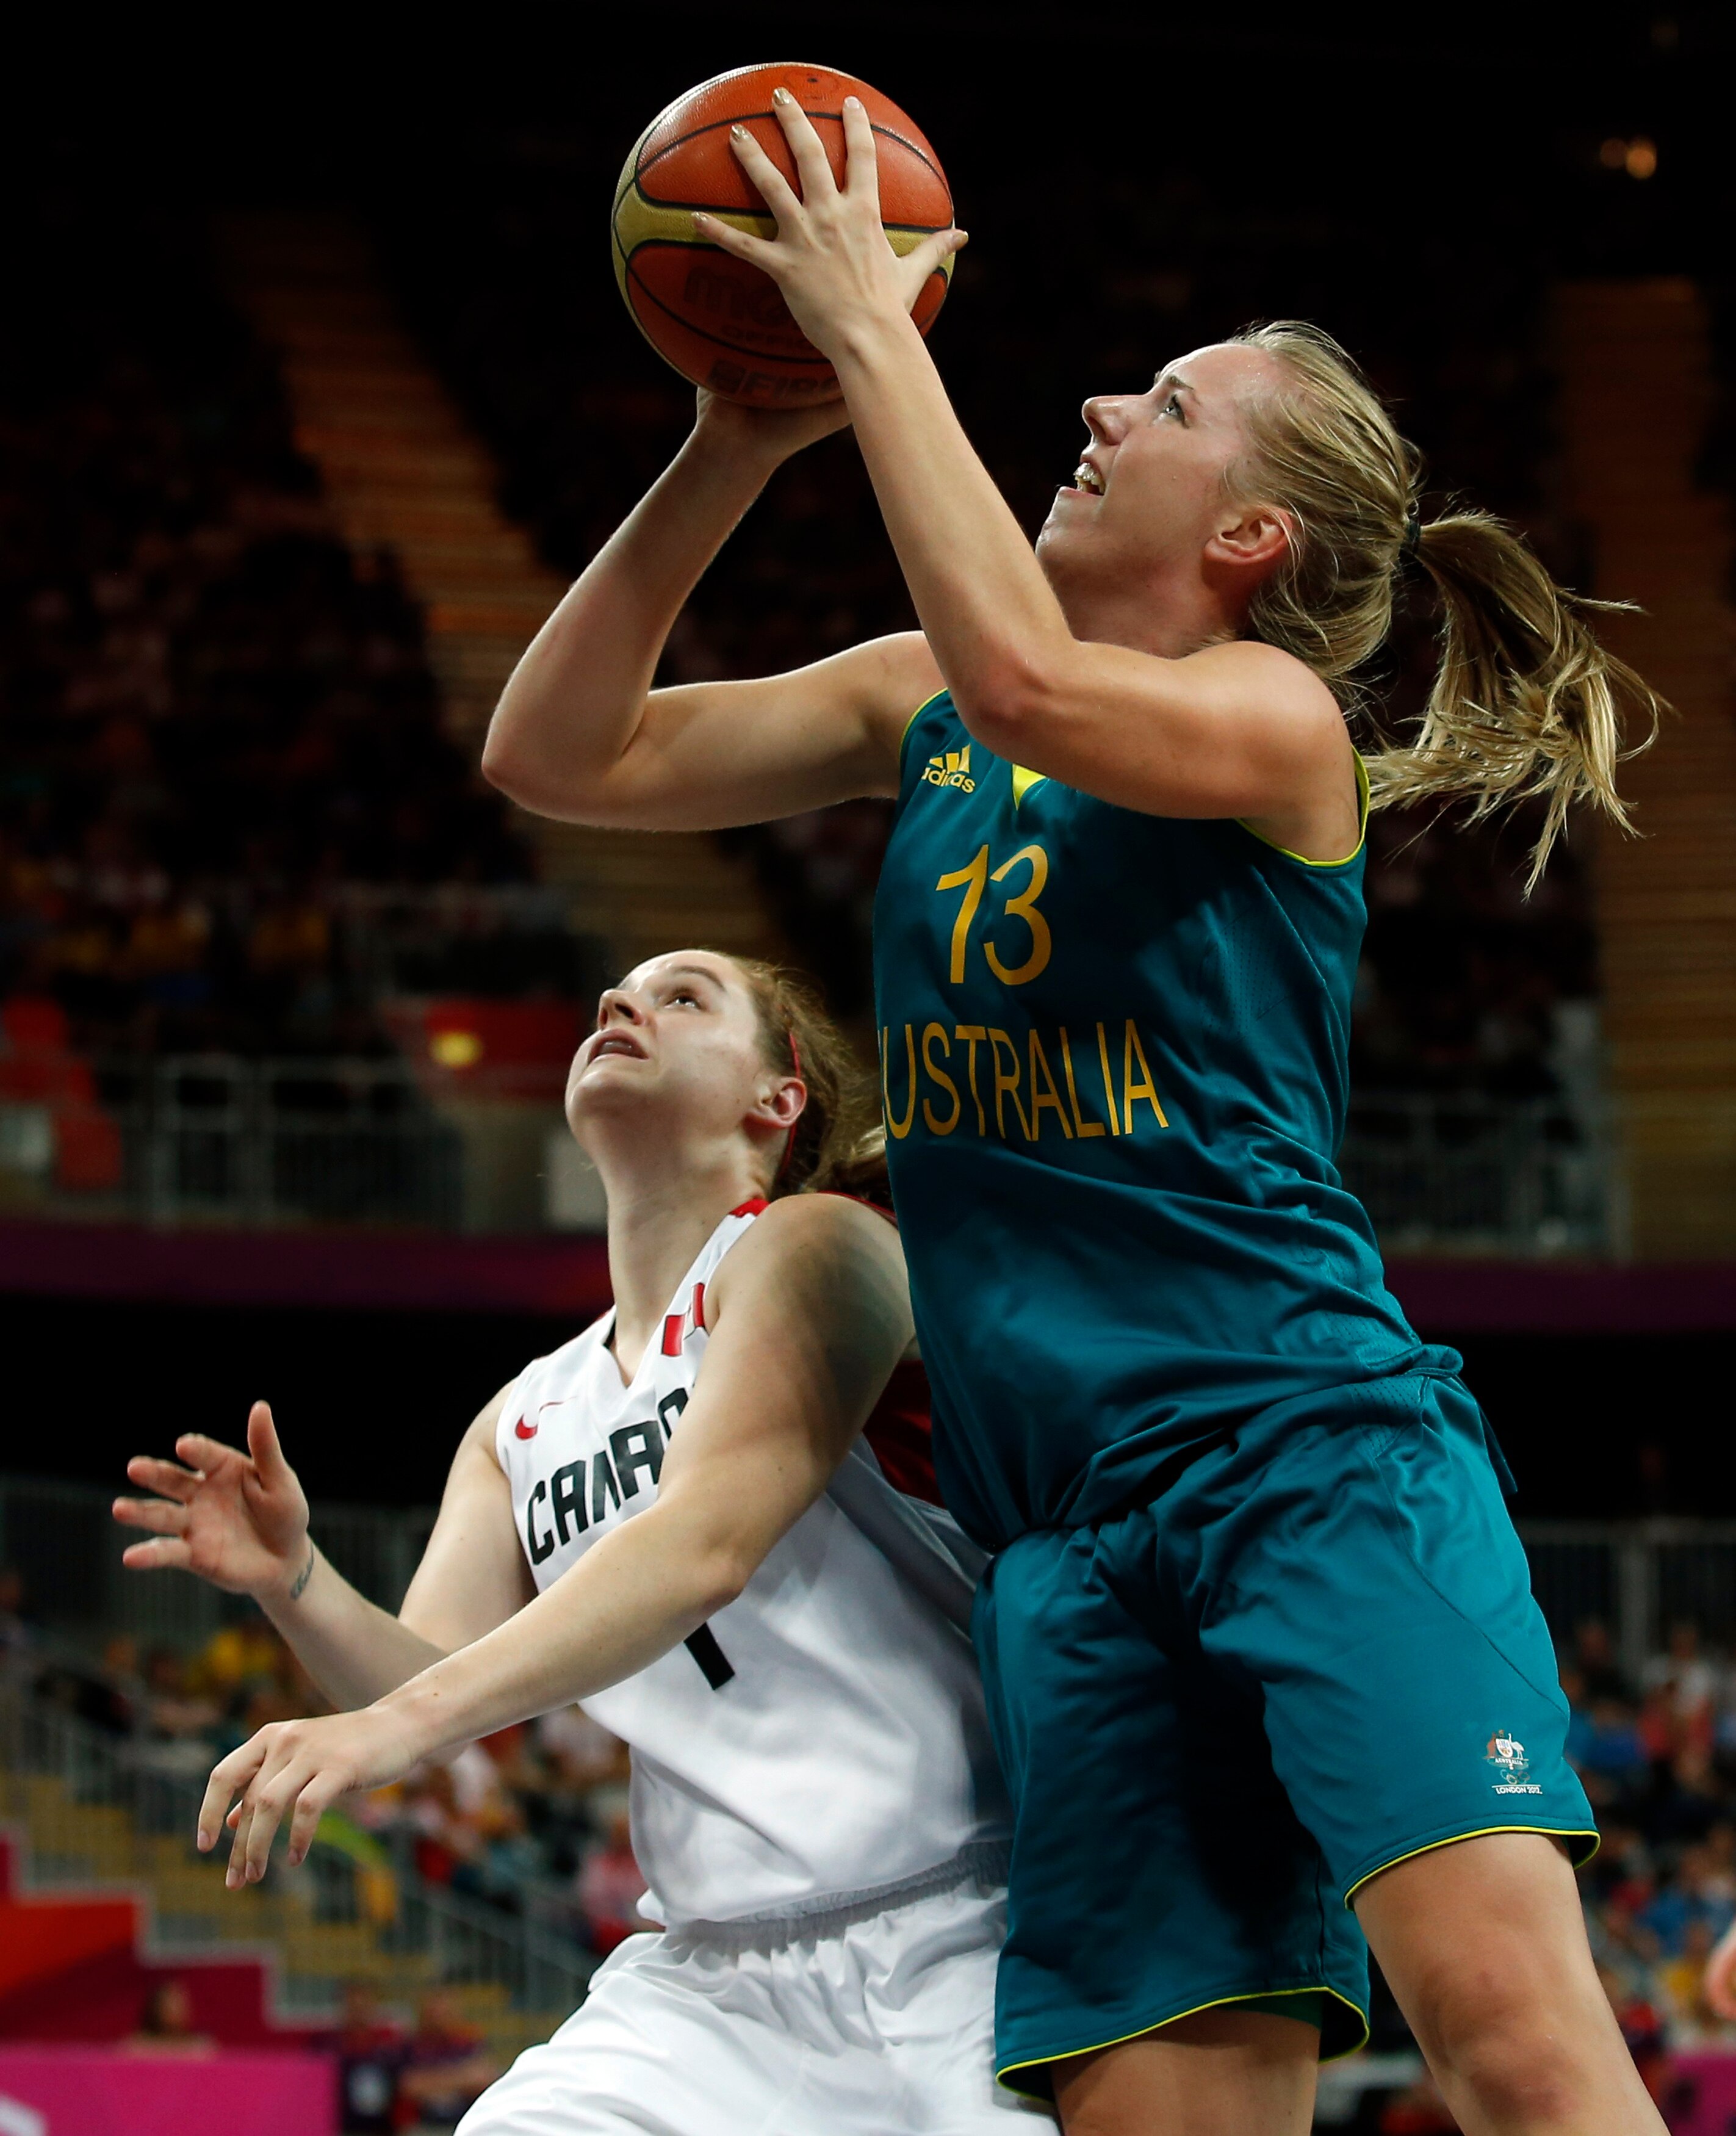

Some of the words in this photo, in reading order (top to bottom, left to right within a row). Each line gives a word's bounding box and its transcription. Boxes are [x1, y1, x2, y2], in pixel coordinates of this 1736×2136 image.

[936, 843, 1052, 986] 13
[877, 1019, 1169, 1142] USTRALIA
[1496, 1786, 1527, 1795] LONDON
